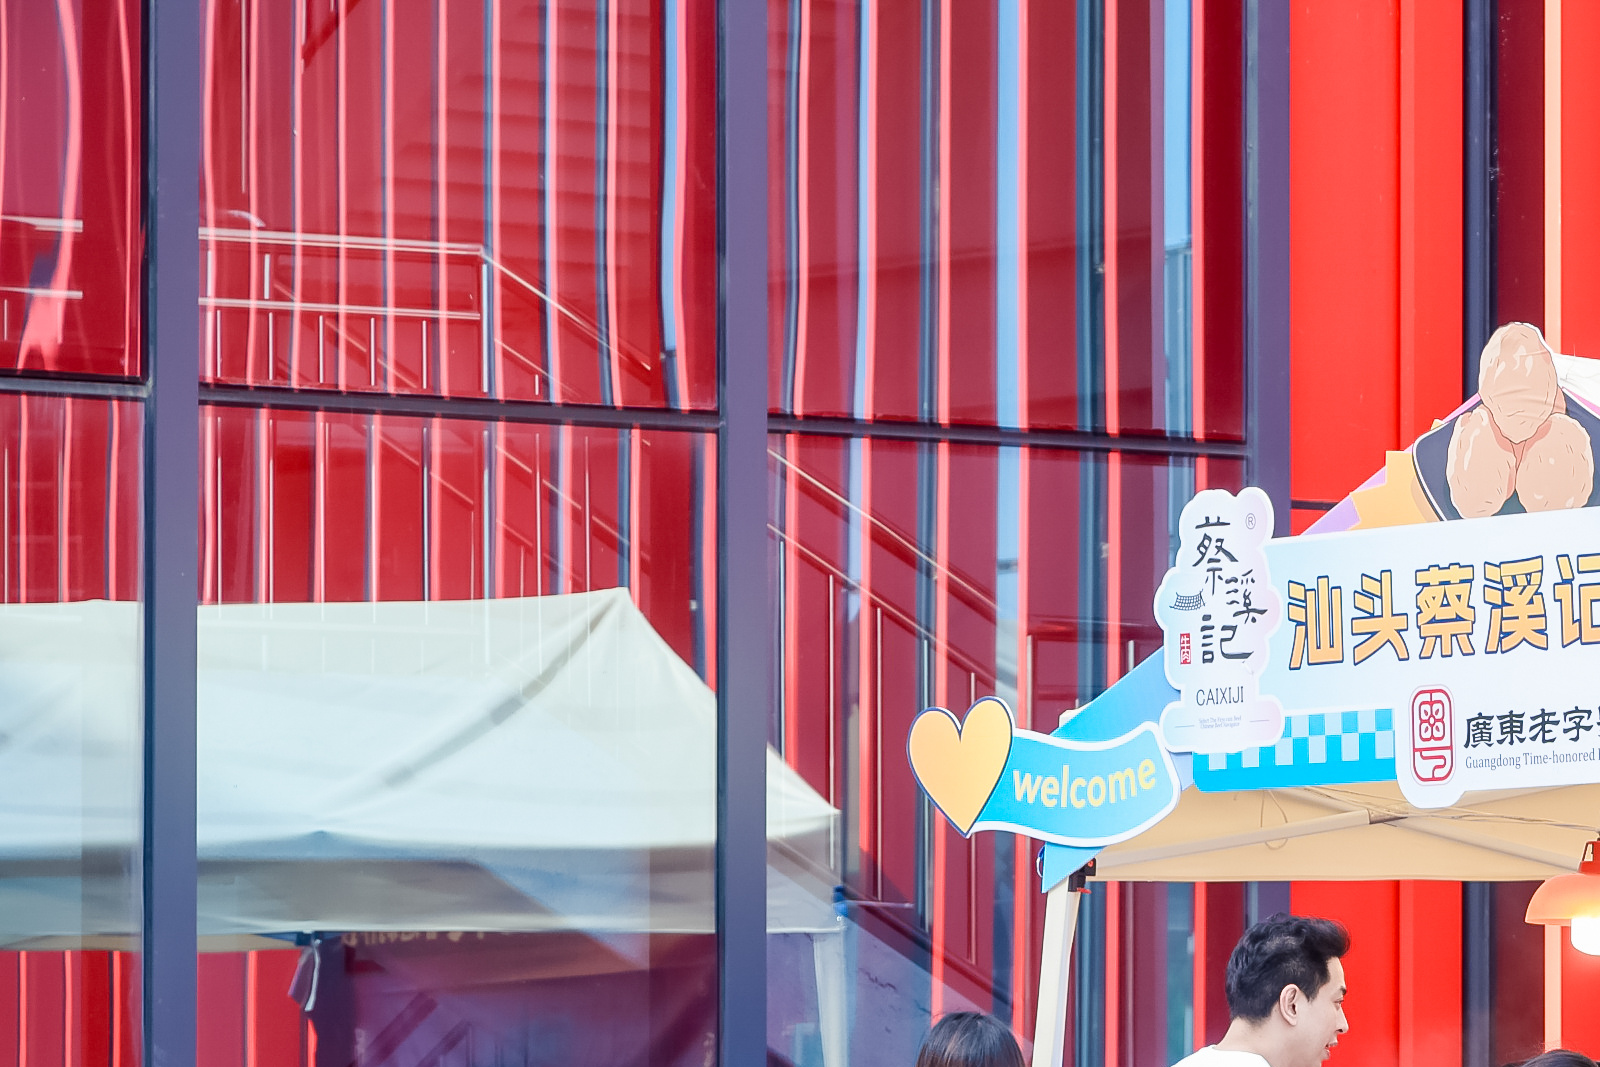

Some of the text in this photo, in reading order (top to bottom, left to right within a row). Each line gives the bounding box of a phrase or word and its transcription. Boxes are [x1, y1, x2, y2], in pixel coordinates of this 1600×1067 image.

[1192, 515, 1268, 665] 蔡溪記
[1195, 685, 1244, 706] CAIXIJI
[1465, 752, 1522, 771] Guangdong
[1522, 748, 1596, 766] Time-honored
[1012, 758, 1156, 809] welcome
